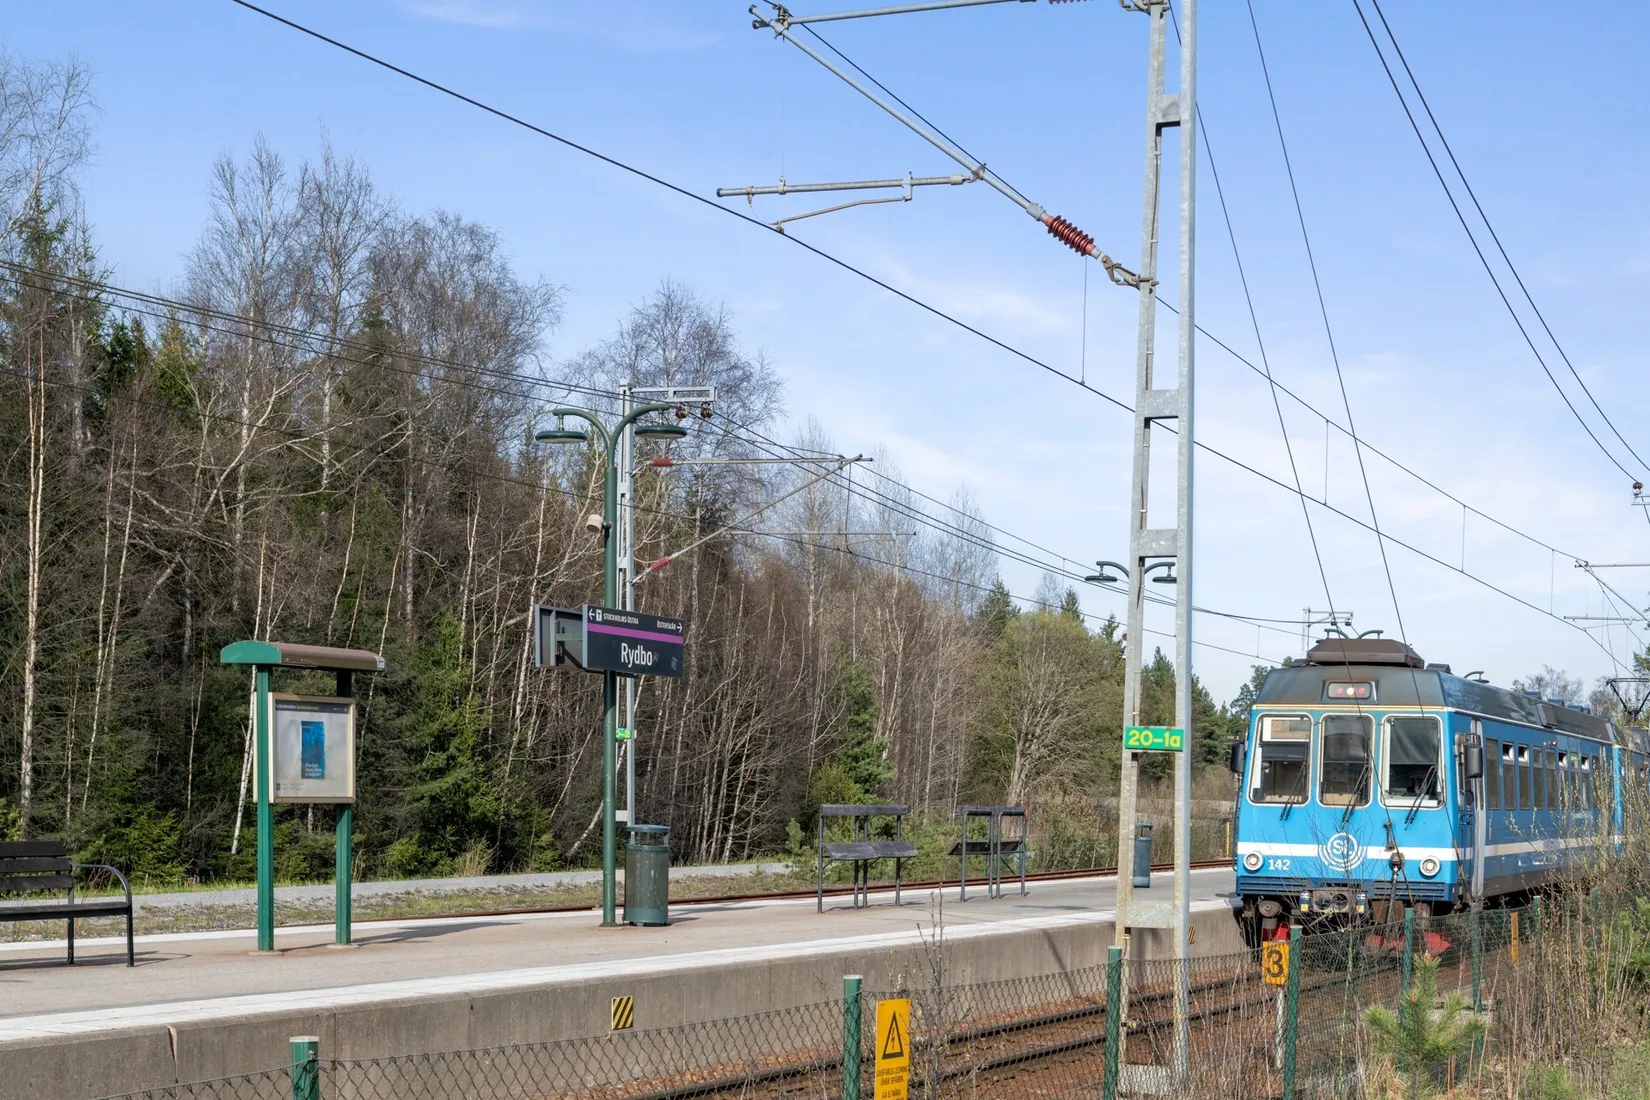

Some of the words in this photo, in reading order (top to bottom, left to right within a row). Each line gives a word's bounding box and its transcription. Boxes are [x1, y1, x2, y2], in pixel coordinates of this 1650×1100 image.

[621, 642, 653, 668] Rydbo
[1128, 729, 1181, 748] 20-1a
[1332, 839, 1353, 855] SL
[1268, 858, 1291, 871] 142
[1267, 949, 1284, 977] 3
